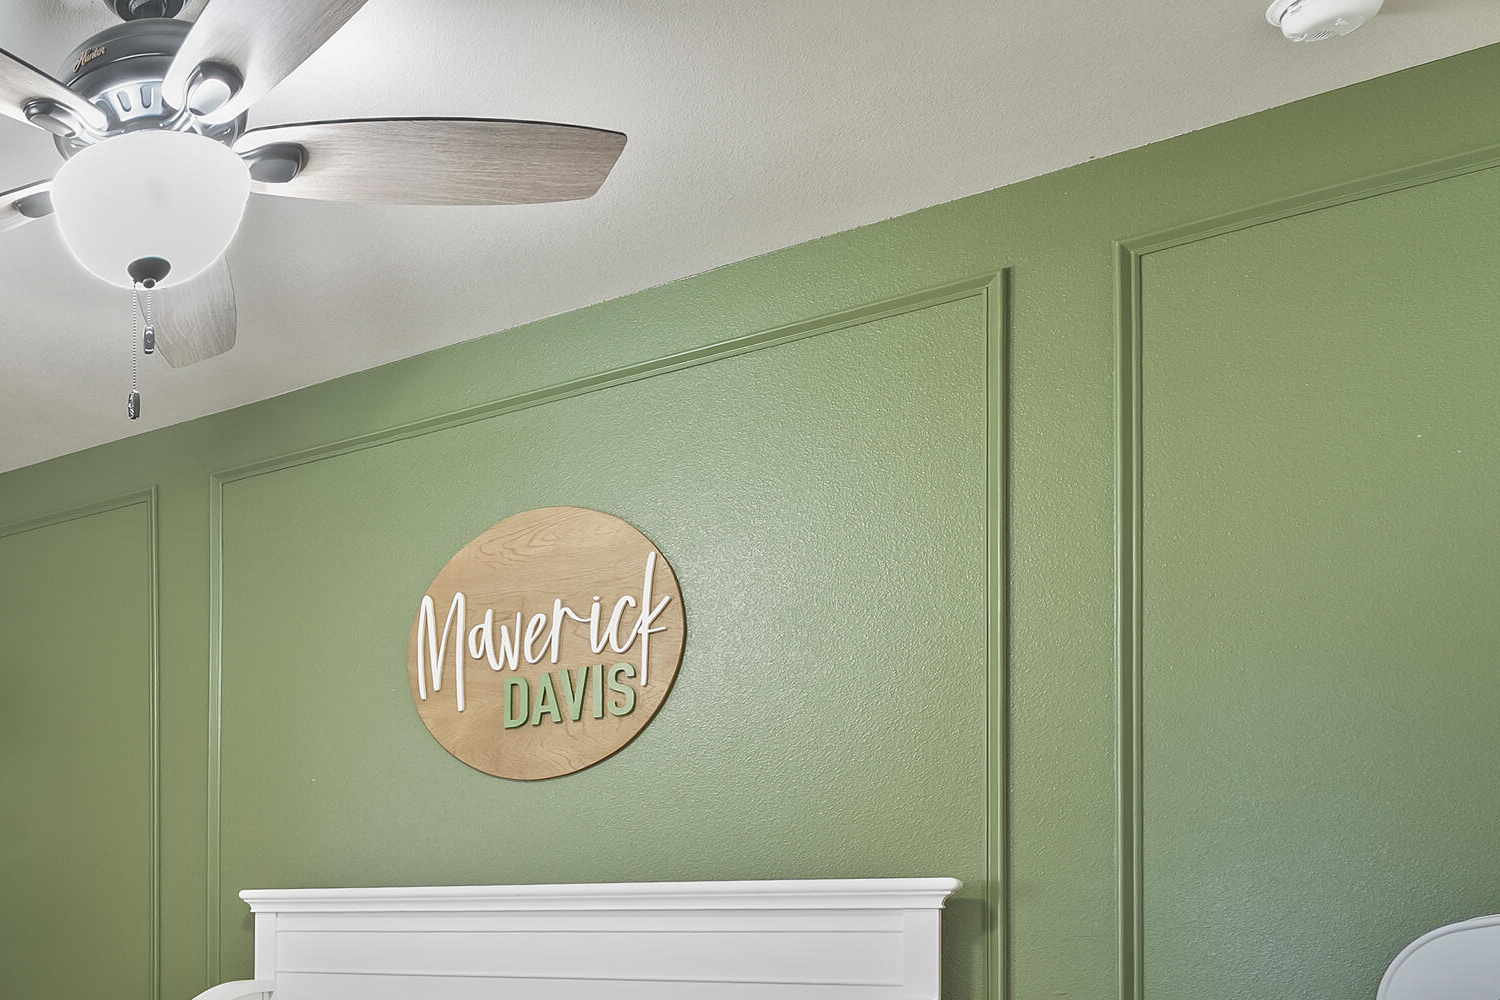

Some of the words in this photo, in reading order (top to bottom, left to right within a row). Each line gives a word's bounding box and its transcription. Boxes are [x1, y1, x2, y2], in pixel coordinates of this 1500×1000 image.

[73, 47, 105, 72] Hunter
[417, 551, 672, 712] Maverick
[503, 662, 637, 729] DAVIS
